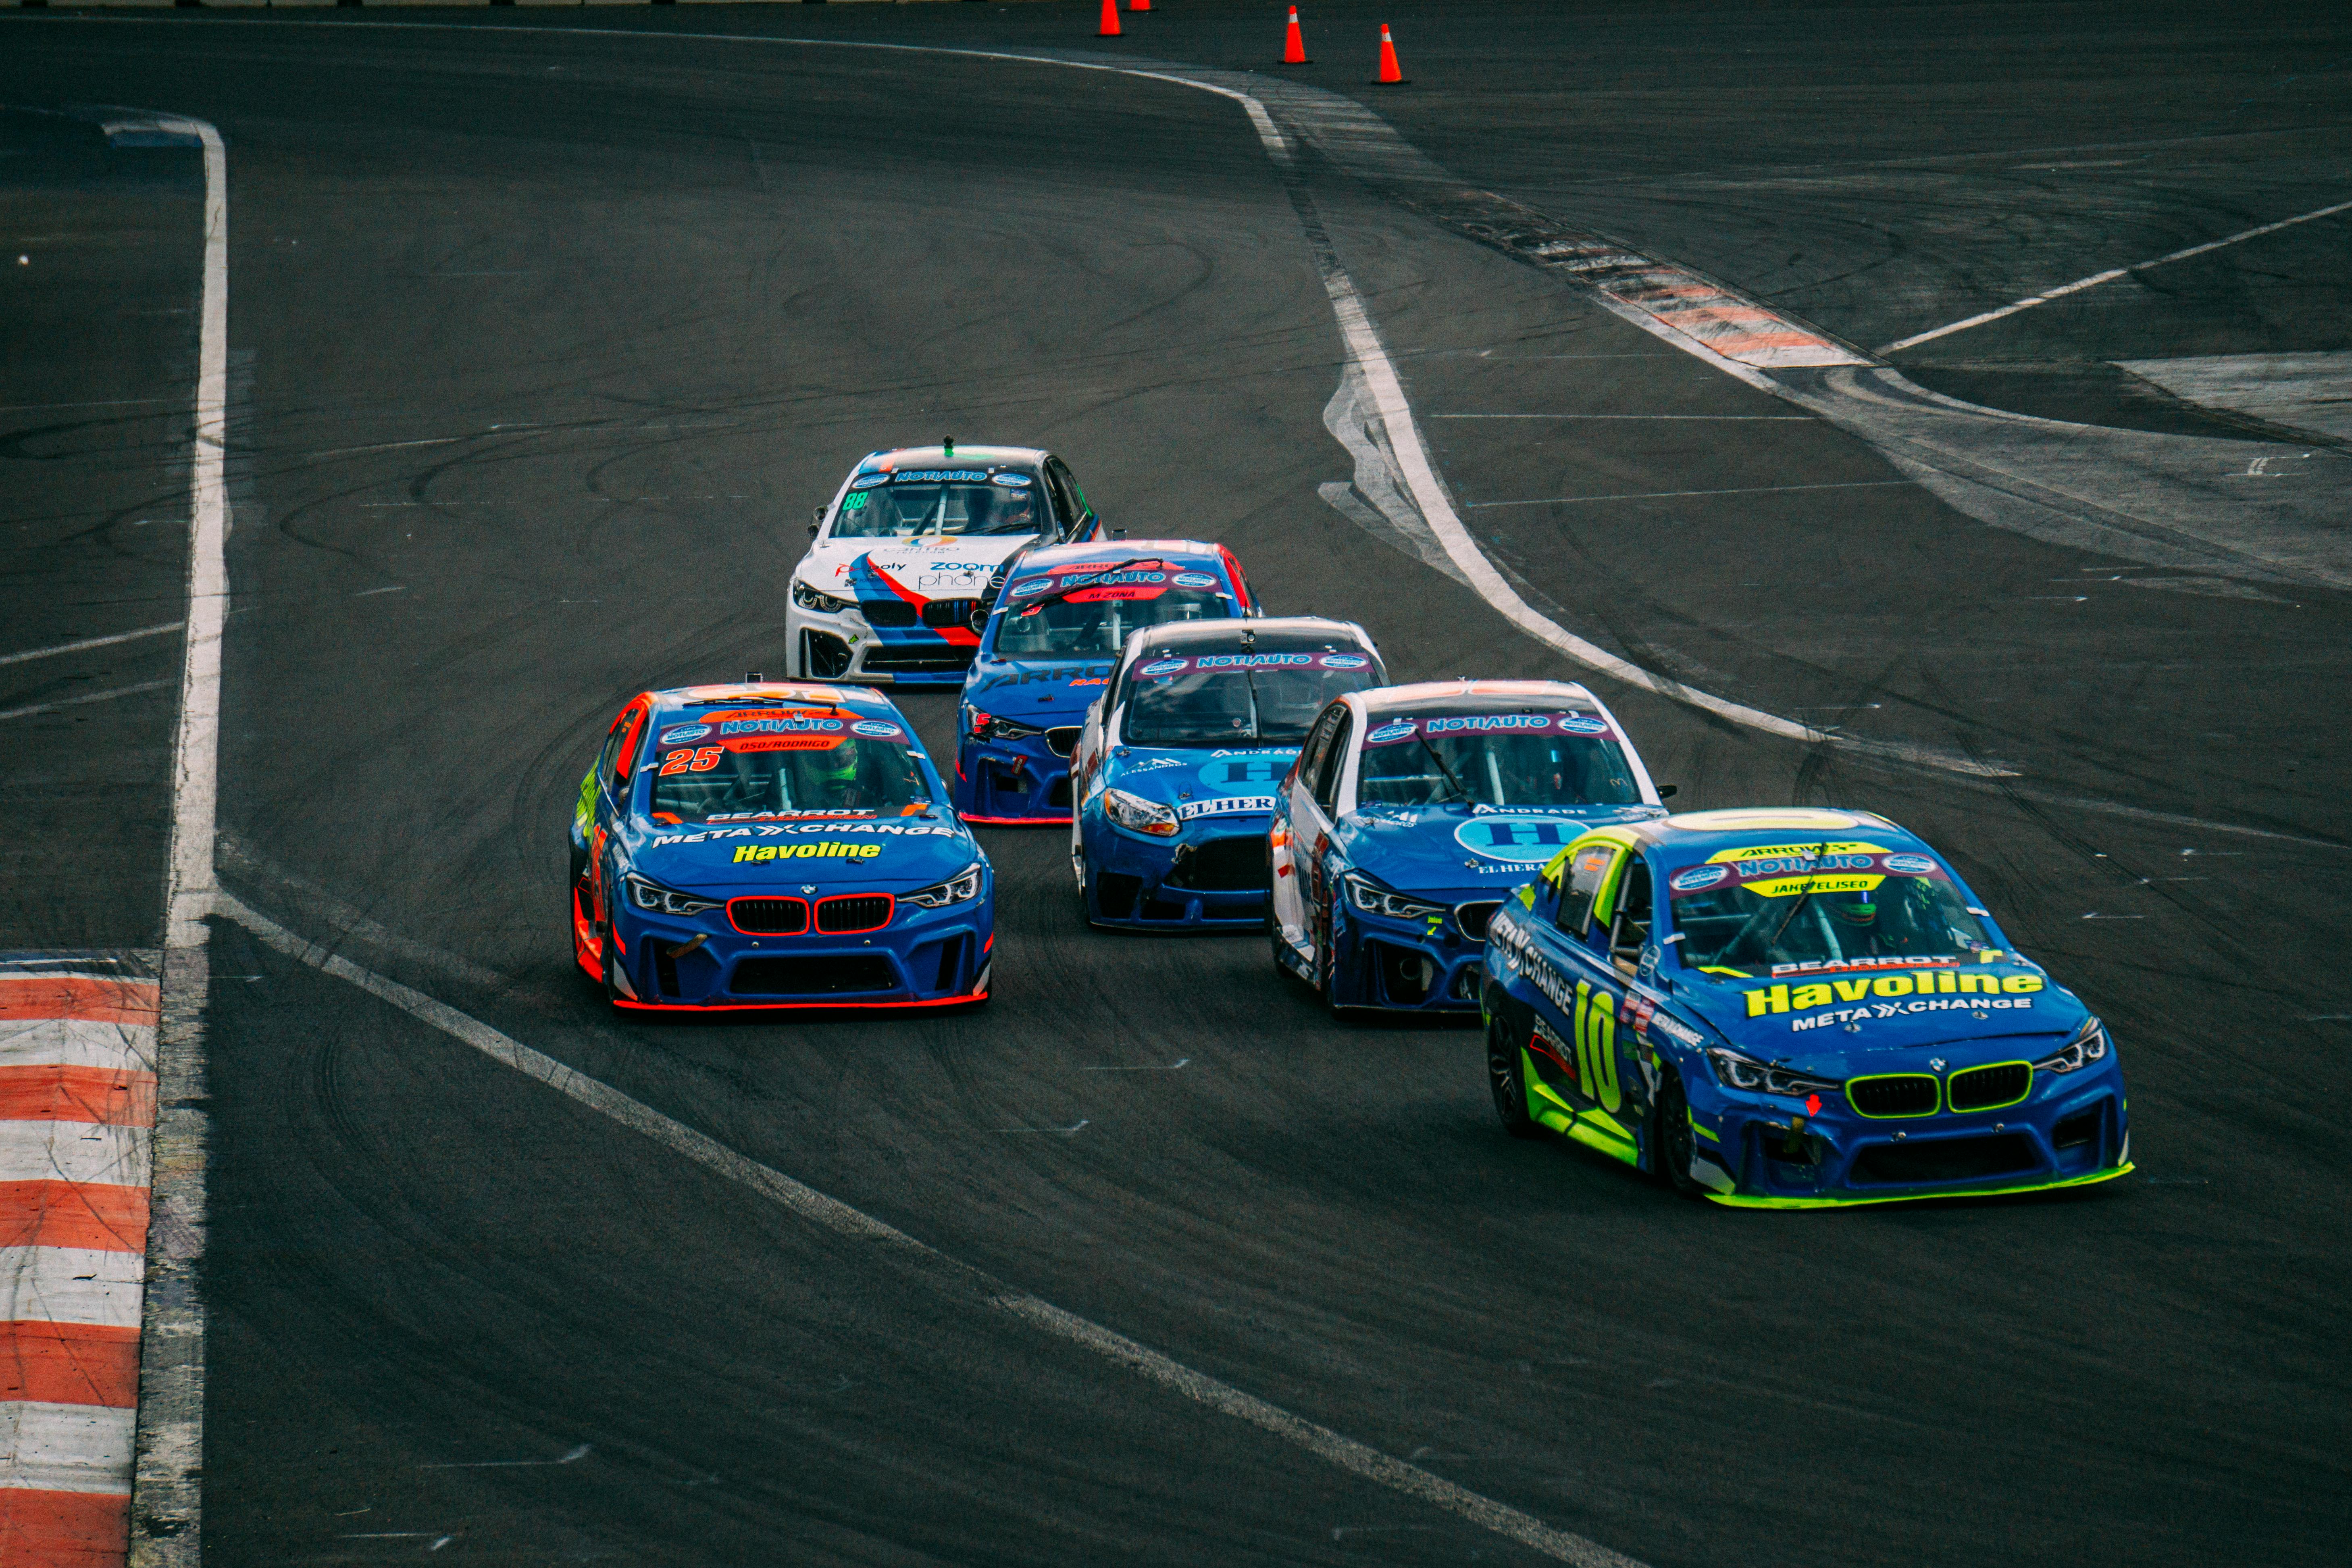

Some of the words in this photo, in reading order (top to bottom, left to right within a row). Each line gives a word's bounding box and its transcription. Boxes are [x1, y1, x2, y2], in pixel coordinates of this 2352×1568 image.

[894, 470, 988, 482] NOTIAUTO
[843, 492, 868, 510] 88
[930, 562, 1004, 573] zoom
[918, 572, 1005, 590] phone
[1060, 571, 1166, 587] NOTIAUTO
[1197, 654, 1312, 668] NOTIAUTO
[720, 718, 843, 735] NOTIAUTO
[974, 713, 992, 733] 5
[1426, 715, 1551, 733] NOTIAUTO
[667, 729, 705, 739] NOTIAUTO
[659, 747, 725, 777] 25
[1220, 761, 1293, 783] H
[706, 809, 874, 820] BEARROT
[1182, 804, 1209, 818] EL
[1472, 804, 1587, 814] ANDRADE
[1481, 823, 1571, 846] H
[733, 842, 881, 863] Havoline
[1478, 866, 1499, 874] EL
[1738, 854, 1875, 877] NOTIAUTO
[1771, 956, 1957, 973] BEARROT
[1742, 970, 2043, 1017] Havoline
[1575, 979, 1621, 1113] 10
